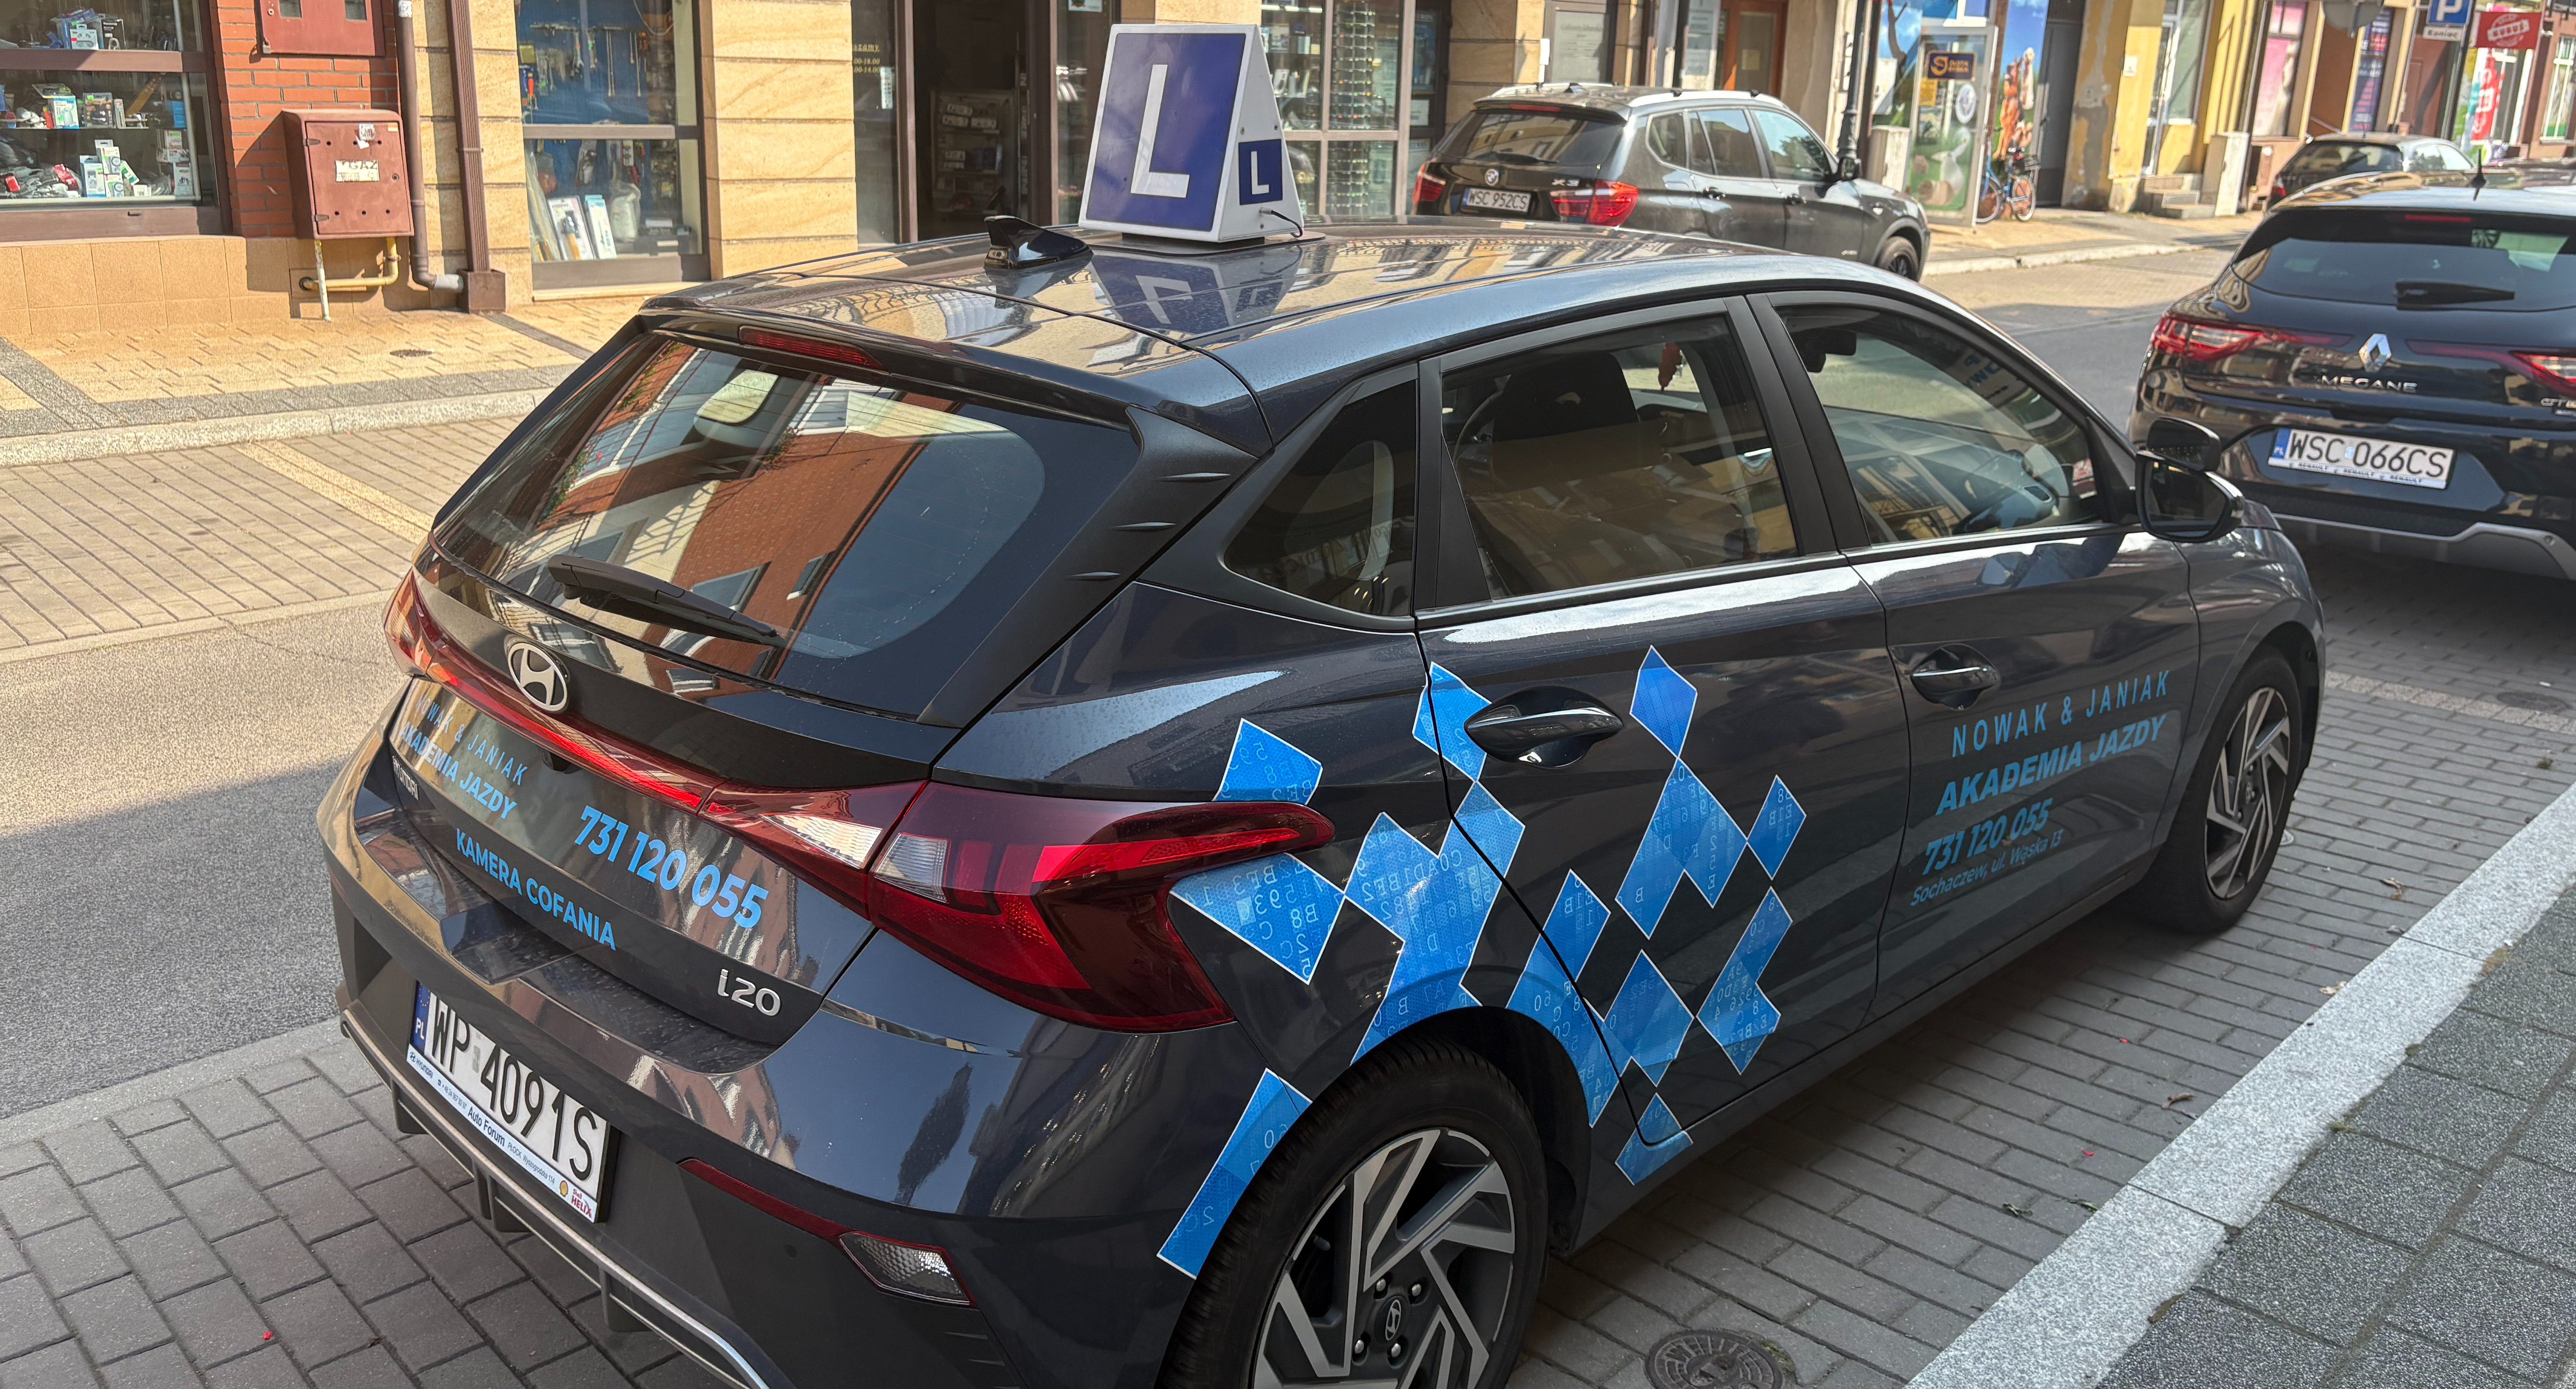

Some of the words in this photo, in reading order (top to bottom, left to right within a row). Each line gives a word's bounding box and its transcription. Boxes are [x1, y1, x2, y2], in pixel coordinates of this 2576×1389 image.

[2436, 0, 2462, 21] P
[1130, 64, 1190, 198] L
[1251, 151, 1270, 195] L
[1469, 189, 1490, 205] WSC
[1493, 193, 1527, 209] 952CS
[2322, 375, 2418, 392] MEGANE
[2288, 433, 2344, 463] WSC
[2352, 442, 2448, 477] 066CS
[2343, 468, 2375, 476] RENAULT
[416, 692, 454, 734] NOWAK
[455, 724, 465, 743] &
[468, 734, 528, 785] JANIAK
[1951, 702, 2048, 758] NOWAK
[2061, 696, 2073, 725] &
[2085, 670, 2170, 718] JANIAK
[392, 755, 419, 801] HYUNDAI
[400, 721, 459, 782] AKADEMIA
[460, 771, 517, 819] JAZDY
[1935, 741, 2082, 816] AKADEMIA
[2089, 714, 2167, 762] JAZDY
[574, 805, 629, 862] 731
[628, 831, 686, 891] 120
[691, 864, 769, 928] 055
[1911, 863, 1988, 906] Sochaczew,
[1991, 850, 2006, 872] ul.
[2010, 837, 2049, 865] Wąska
[2051, 828, 2064, 848] 13
[1922, 830, 1964, 875] 731
[1967, 813, 2006, 858] 120
[2009, 798, 2054, 840] 055
[456, 828, 524, 895] KAMERA
[526, 877, 616, 951] COFANIA
[717, 969, 781, 1017] i20
[415, 1018, 425, 1040] PL
[432, 998, 470, 1074] WP
[480, 1043, 598, 1182] 4091S
[416, 1058, 433, 1079] HYUNDAI
[468, 1106, 482, 1126] Auto
[483, 1119, 505, 1146] Forum
[571, 1196, 593, 1218] HELIX
[573, 1188, 583, 1200] Shell
